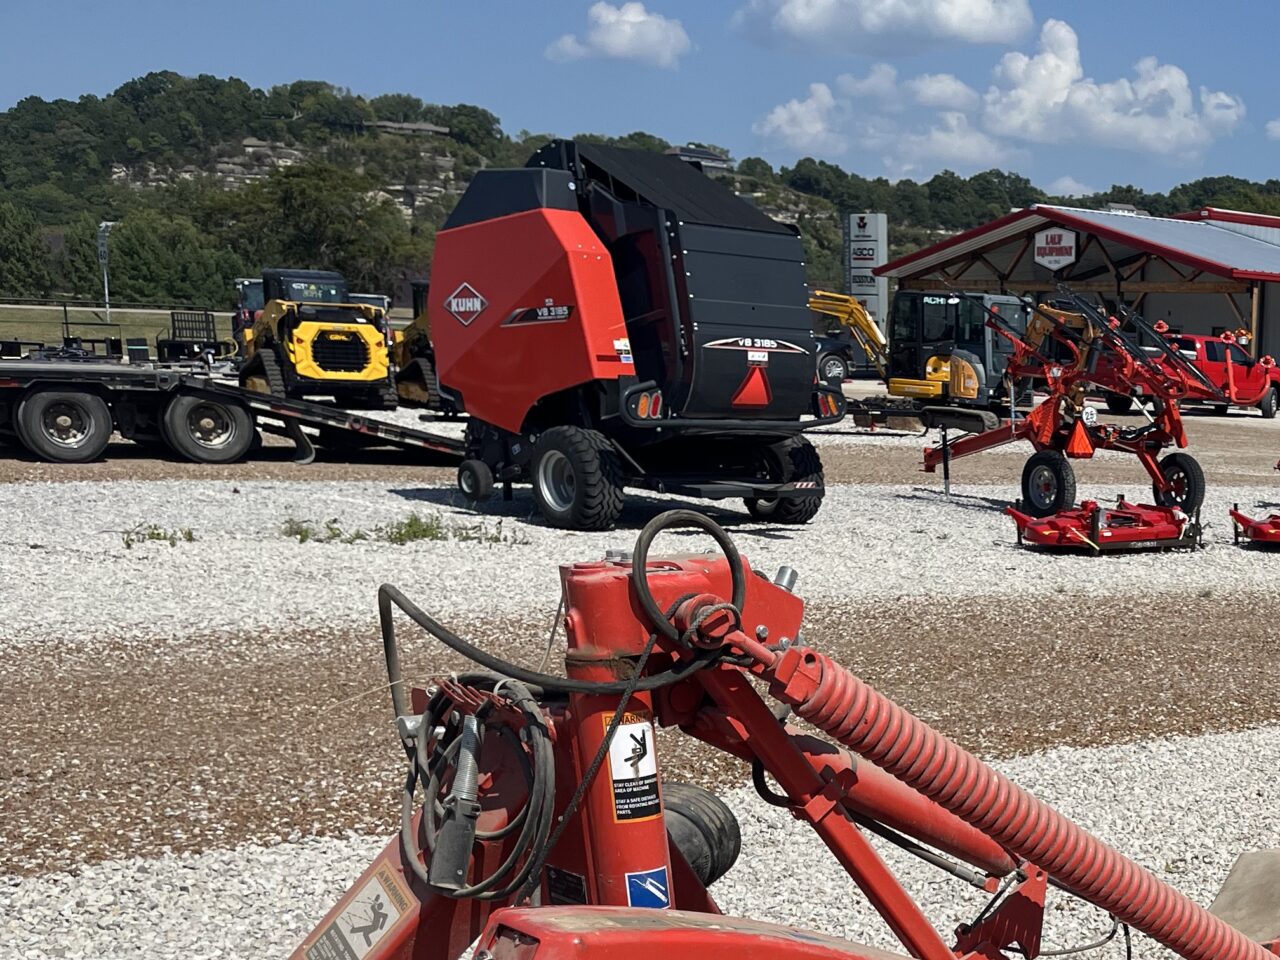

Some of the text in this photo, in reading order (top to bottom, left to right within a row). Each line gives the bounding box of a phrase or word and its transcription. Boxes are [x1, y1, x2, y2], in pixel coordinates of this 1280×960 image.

[852, 248, 875, 256] AGCO
[450, 298, 482, 312] KUHN
[536, 307, 549, 316] VB
[738, 338, 778, 348] VB 3185
[382, 875, 409, 911] WARNING
